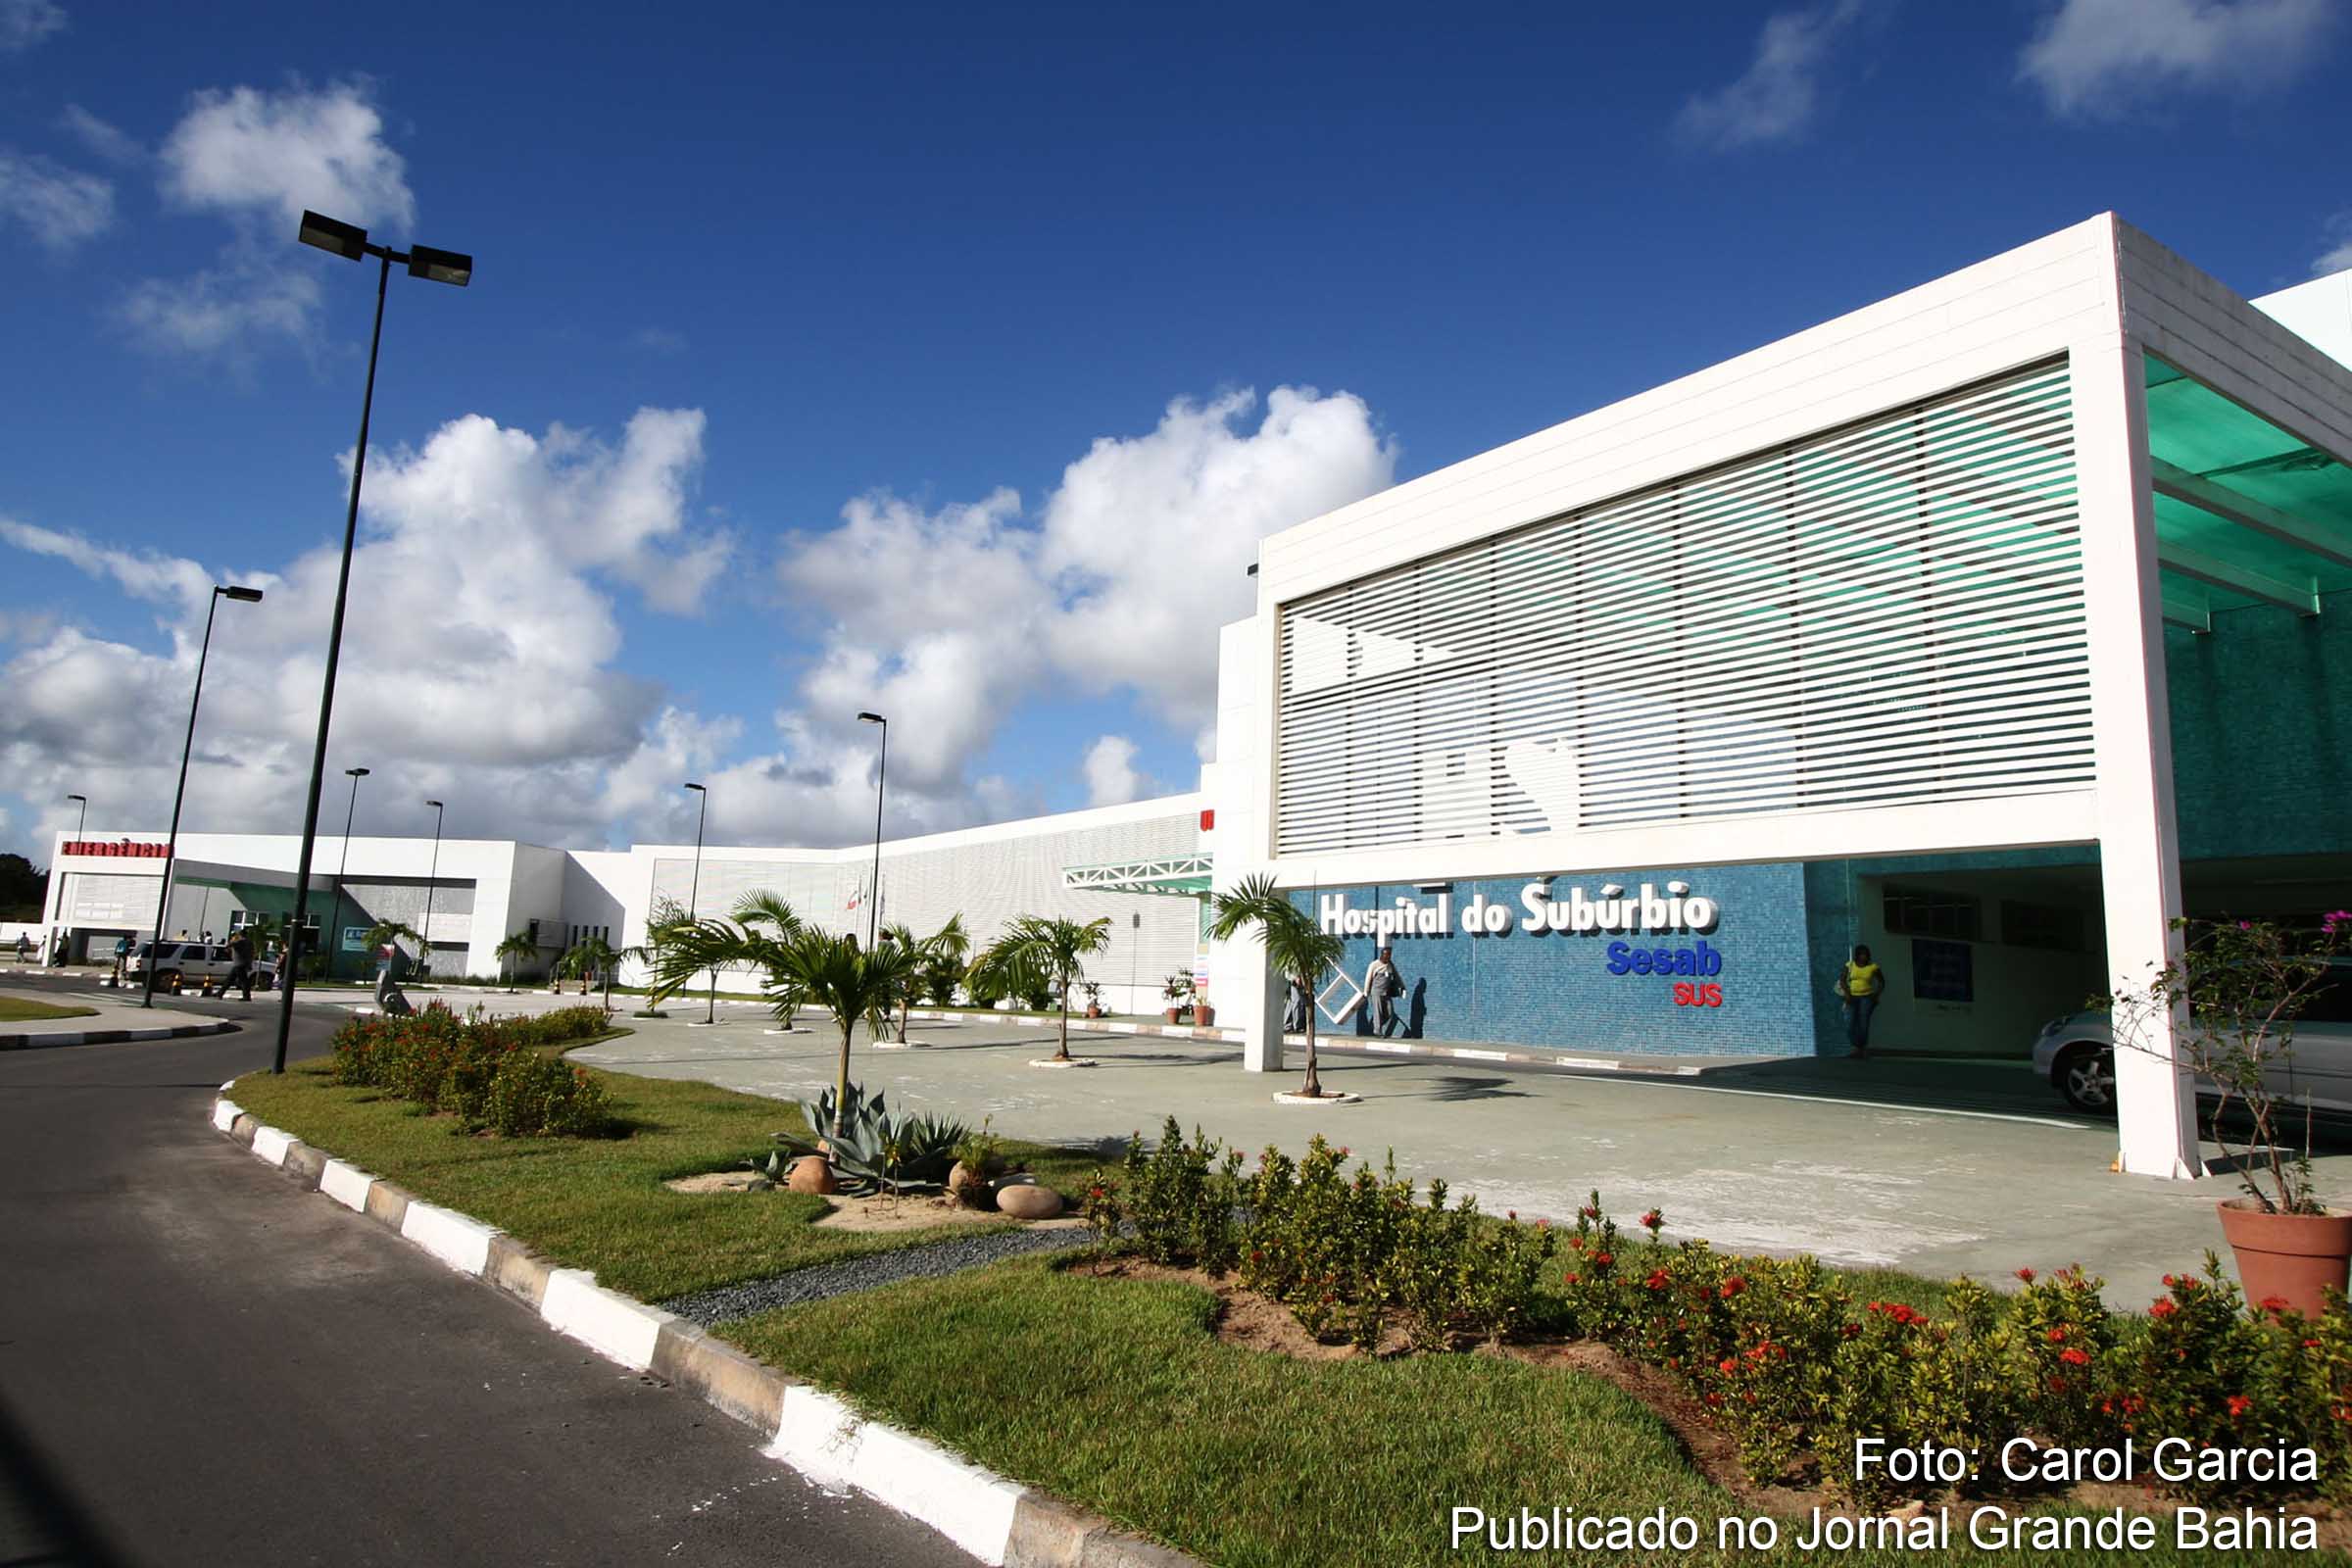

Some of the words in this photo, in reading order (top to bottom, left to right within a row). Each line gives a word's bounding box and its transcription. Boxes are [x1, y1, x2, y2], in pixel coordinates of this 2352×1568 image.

[1320, 893, 1451, 948] Hospital
[1461, 894, 1512, 933] do
[1521, 881, 1718, 931] Subúrbio
[1606, 940, 1722, 976] Sesab
[1673, 982, 1722, 1007] SUS
